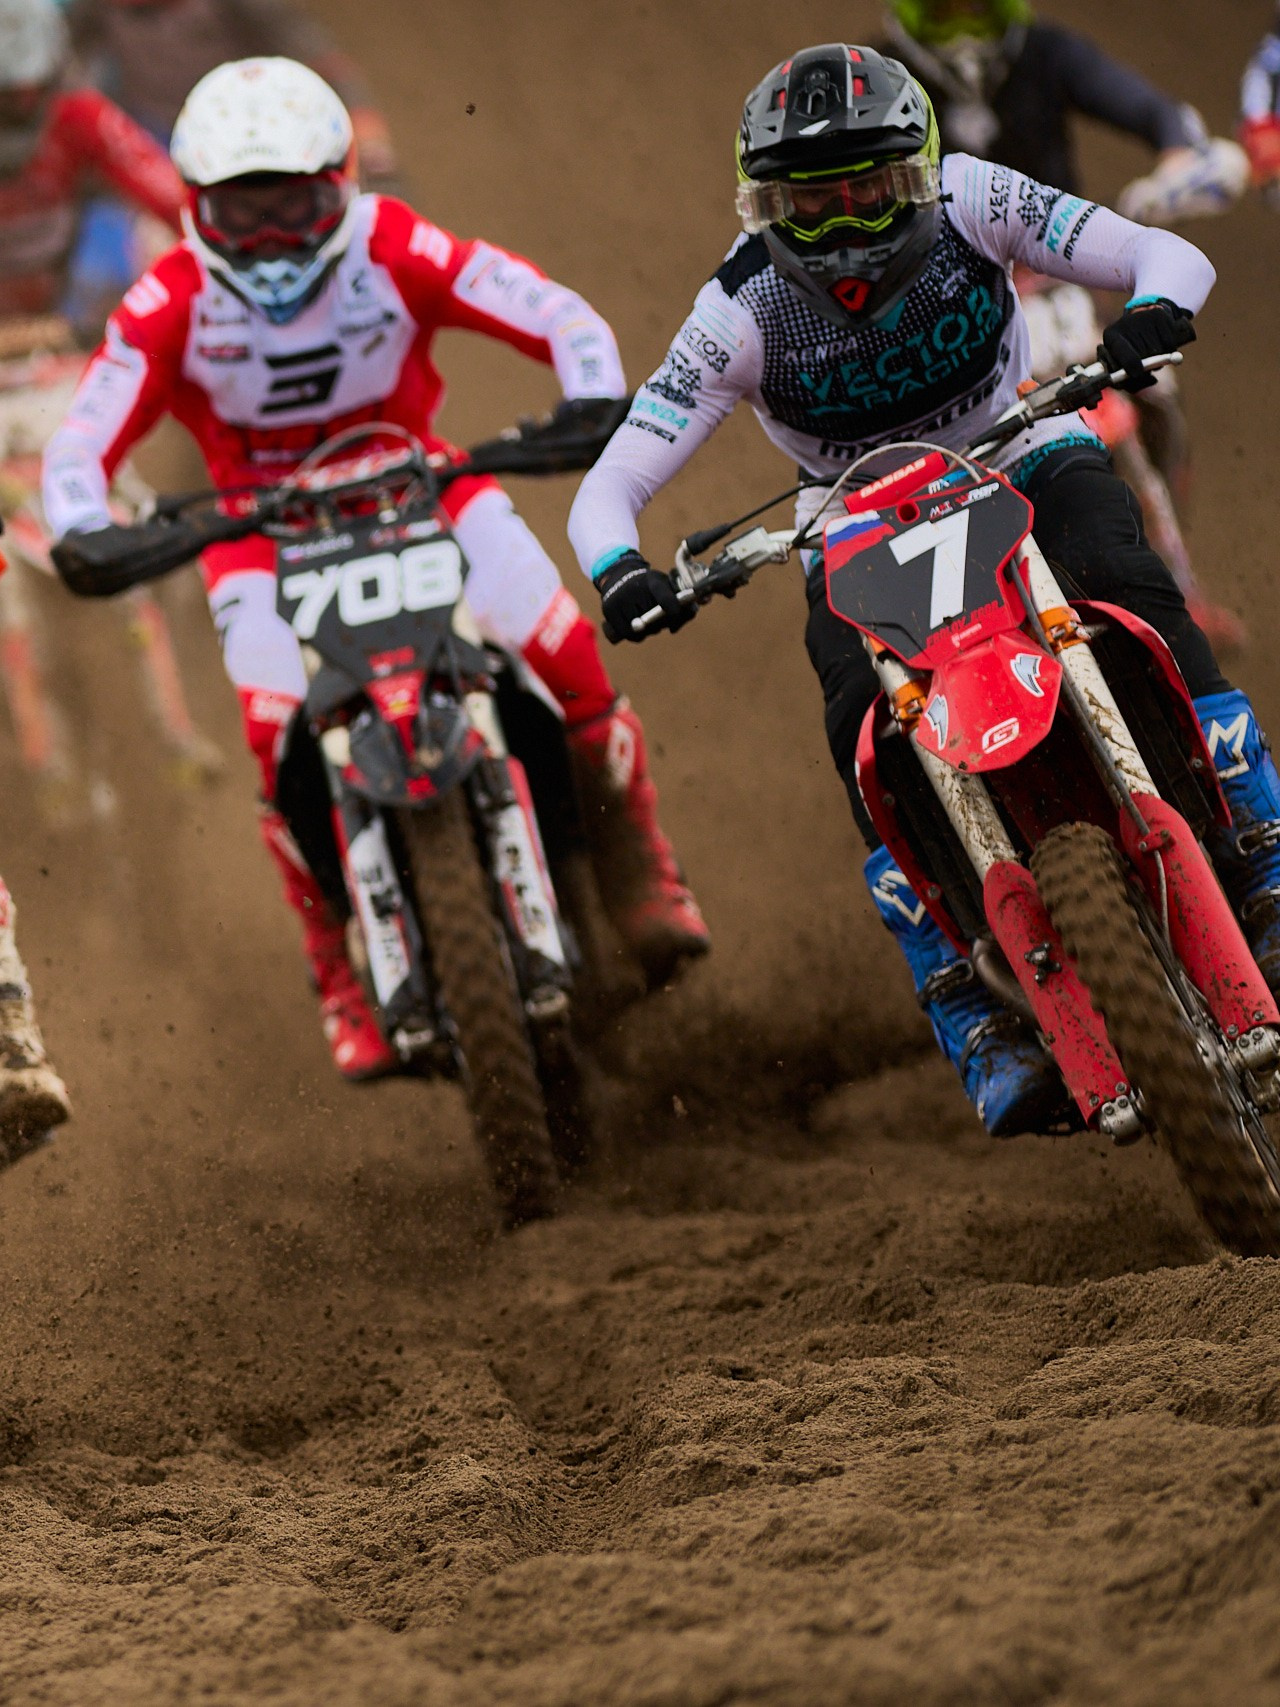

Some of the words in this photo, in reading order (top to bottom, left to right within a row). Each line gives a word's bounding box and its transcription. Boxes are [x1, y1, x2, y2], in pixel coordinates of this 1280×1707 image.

[1046, 198, 1088, 254] KEND
[799, 284, 991, 402] VECTOR
[282, 539, 462, 640] 708
[888, 508, 969, 630] 7
